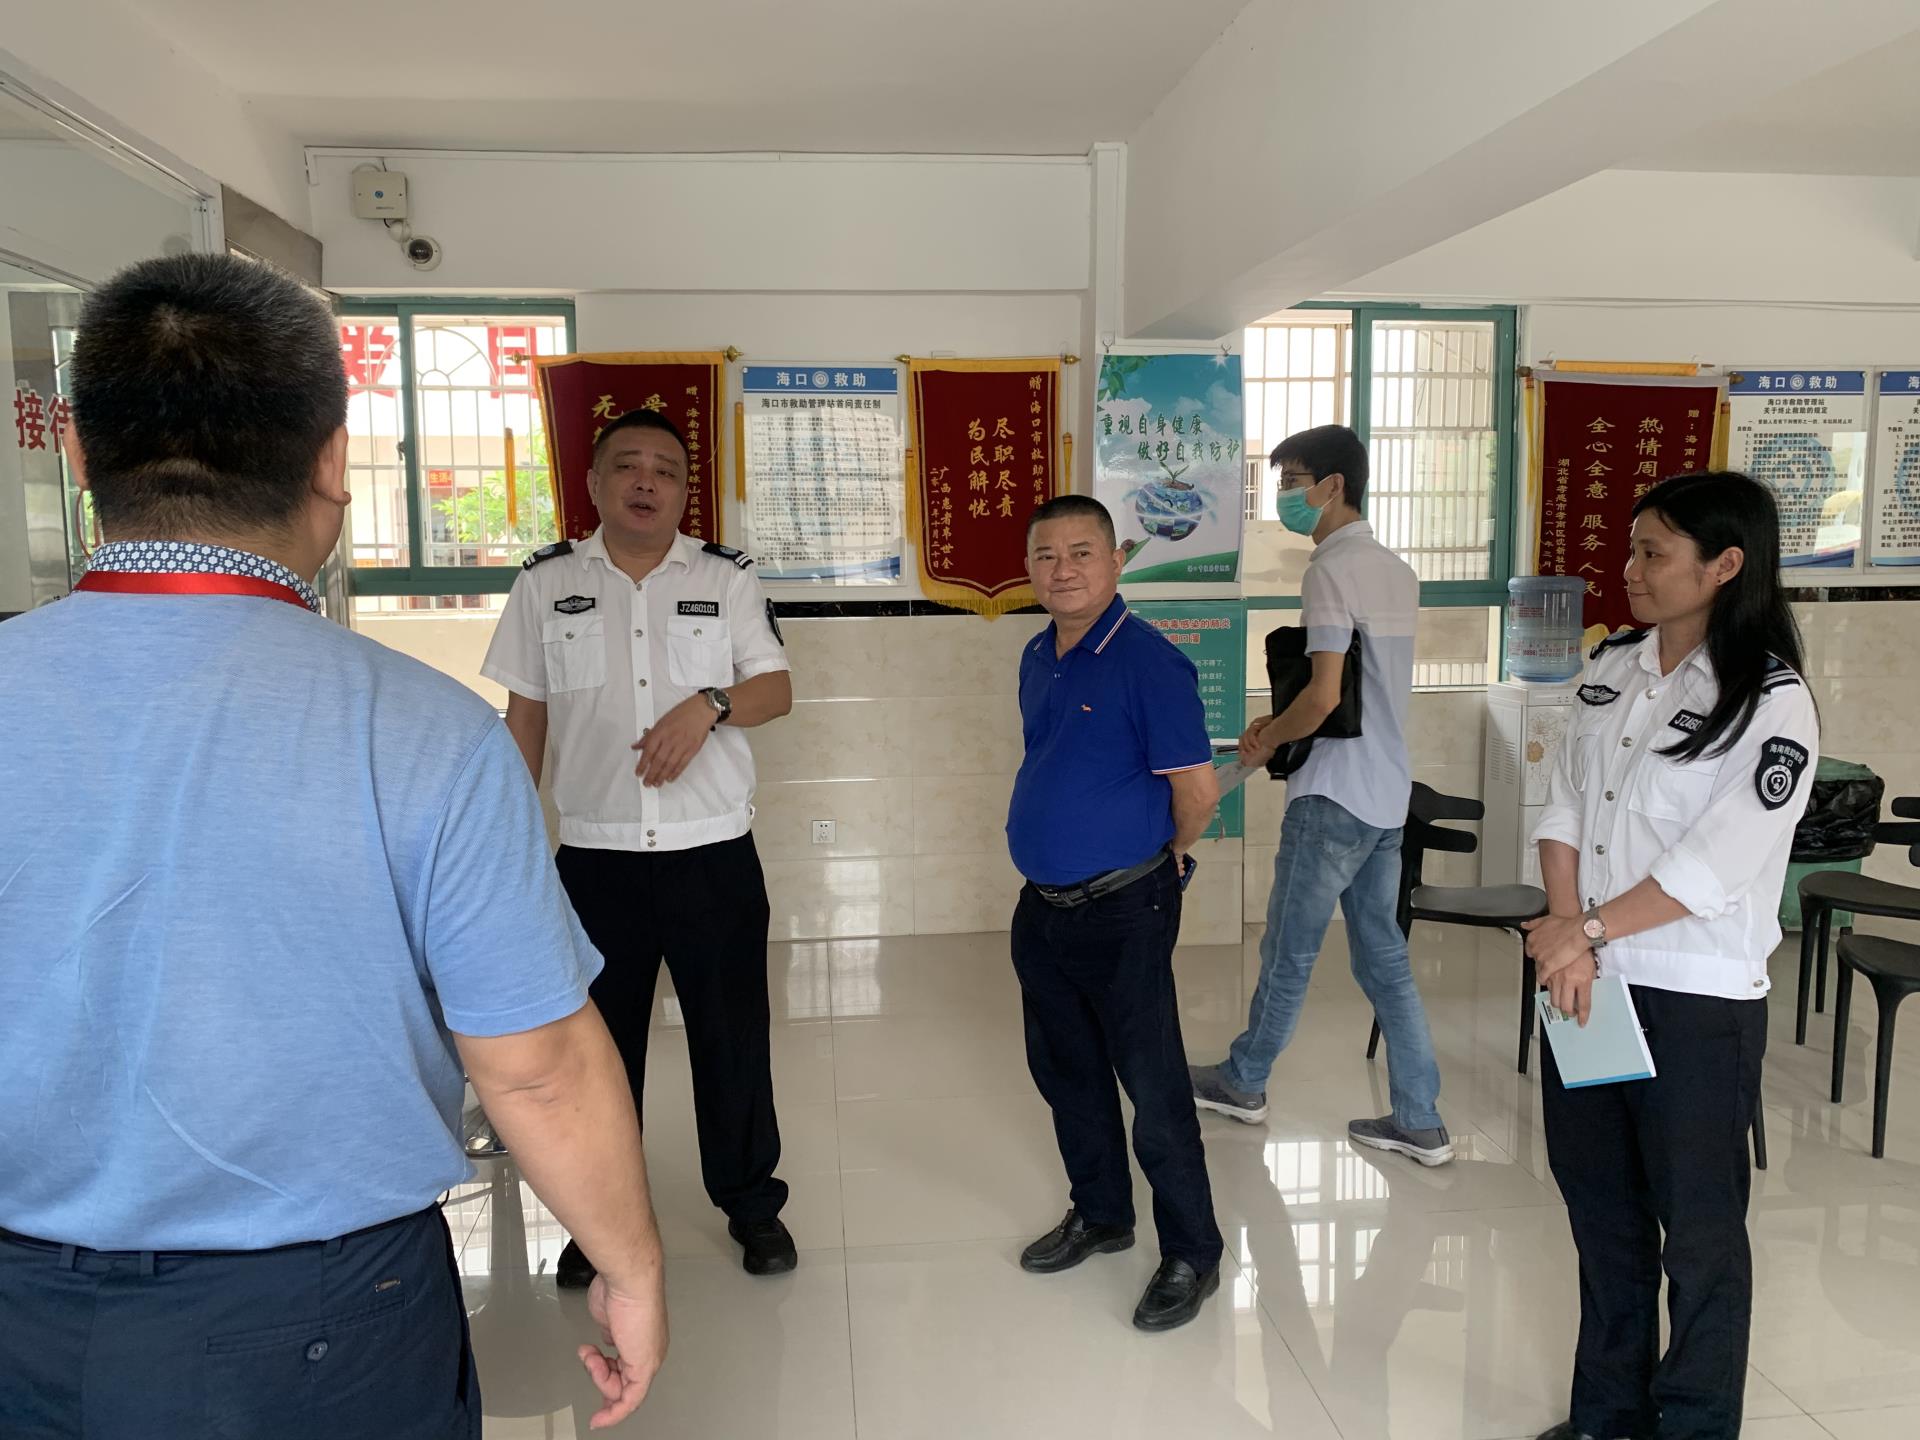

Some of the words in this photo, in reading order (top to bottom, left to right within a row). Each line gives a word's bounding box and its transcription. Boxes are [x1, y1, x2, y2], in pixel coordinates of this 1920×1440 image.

[776, 371, 808, 386] 海口
[834, 372, 867, 387] 救助
[1758, 375, 1786, 389] 海口
[1808, 375, 1838, 389] 救助
[1100, 412, 1203, 436] 重视自身健康
[1137, 438, 1240, 462] 做好自我防护
[967, 417, 991, 519] 为民解忧
[992, 416, 1017, 518] 尽职尽责
[680, 603, 717, 614] JZ460101
